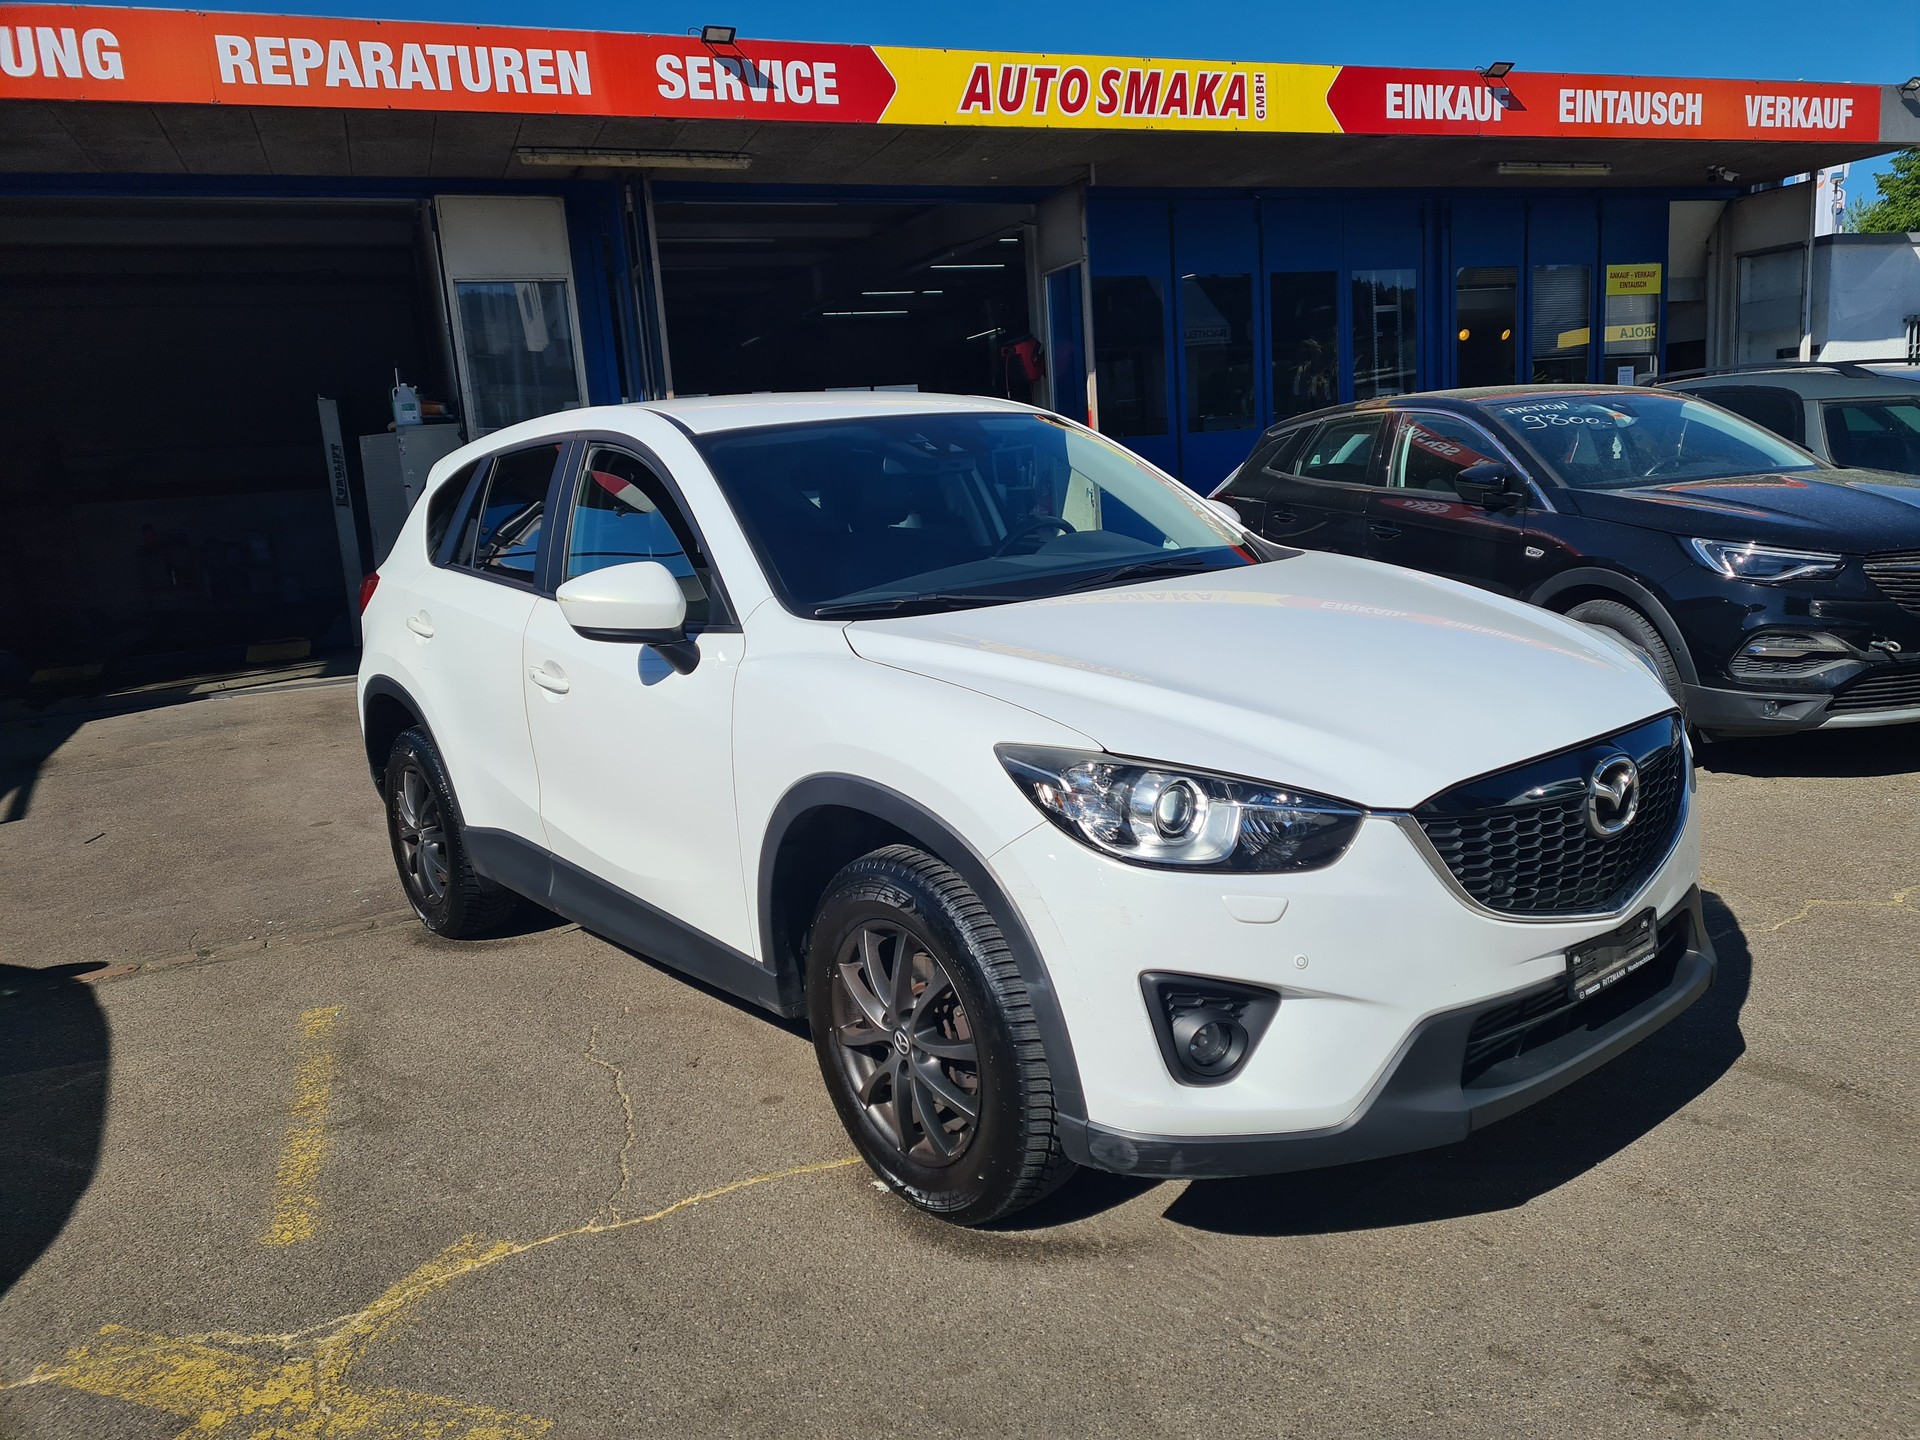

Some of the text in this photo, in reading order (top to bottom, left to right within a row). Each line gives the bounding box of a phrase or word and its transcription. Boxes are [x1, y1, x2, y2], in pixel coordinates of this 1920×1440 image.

[0, 25, 124, 80] UNG
[214, 34, 592, 96] REPARATUREN
[655, 54, 840, 105] SERVICE
[959, 64, 1247, 119] AUTO SMAKA
[1255, 73, 1266, 119] GMBH
[1385, 82, 1509, 122] EINKAUF
[1558, 88, 1703, 126] EINTAUSCH
[1745, 94, 1853, 130] VERKAUF
[1634, 270, 1656, 278] VERKAUF
